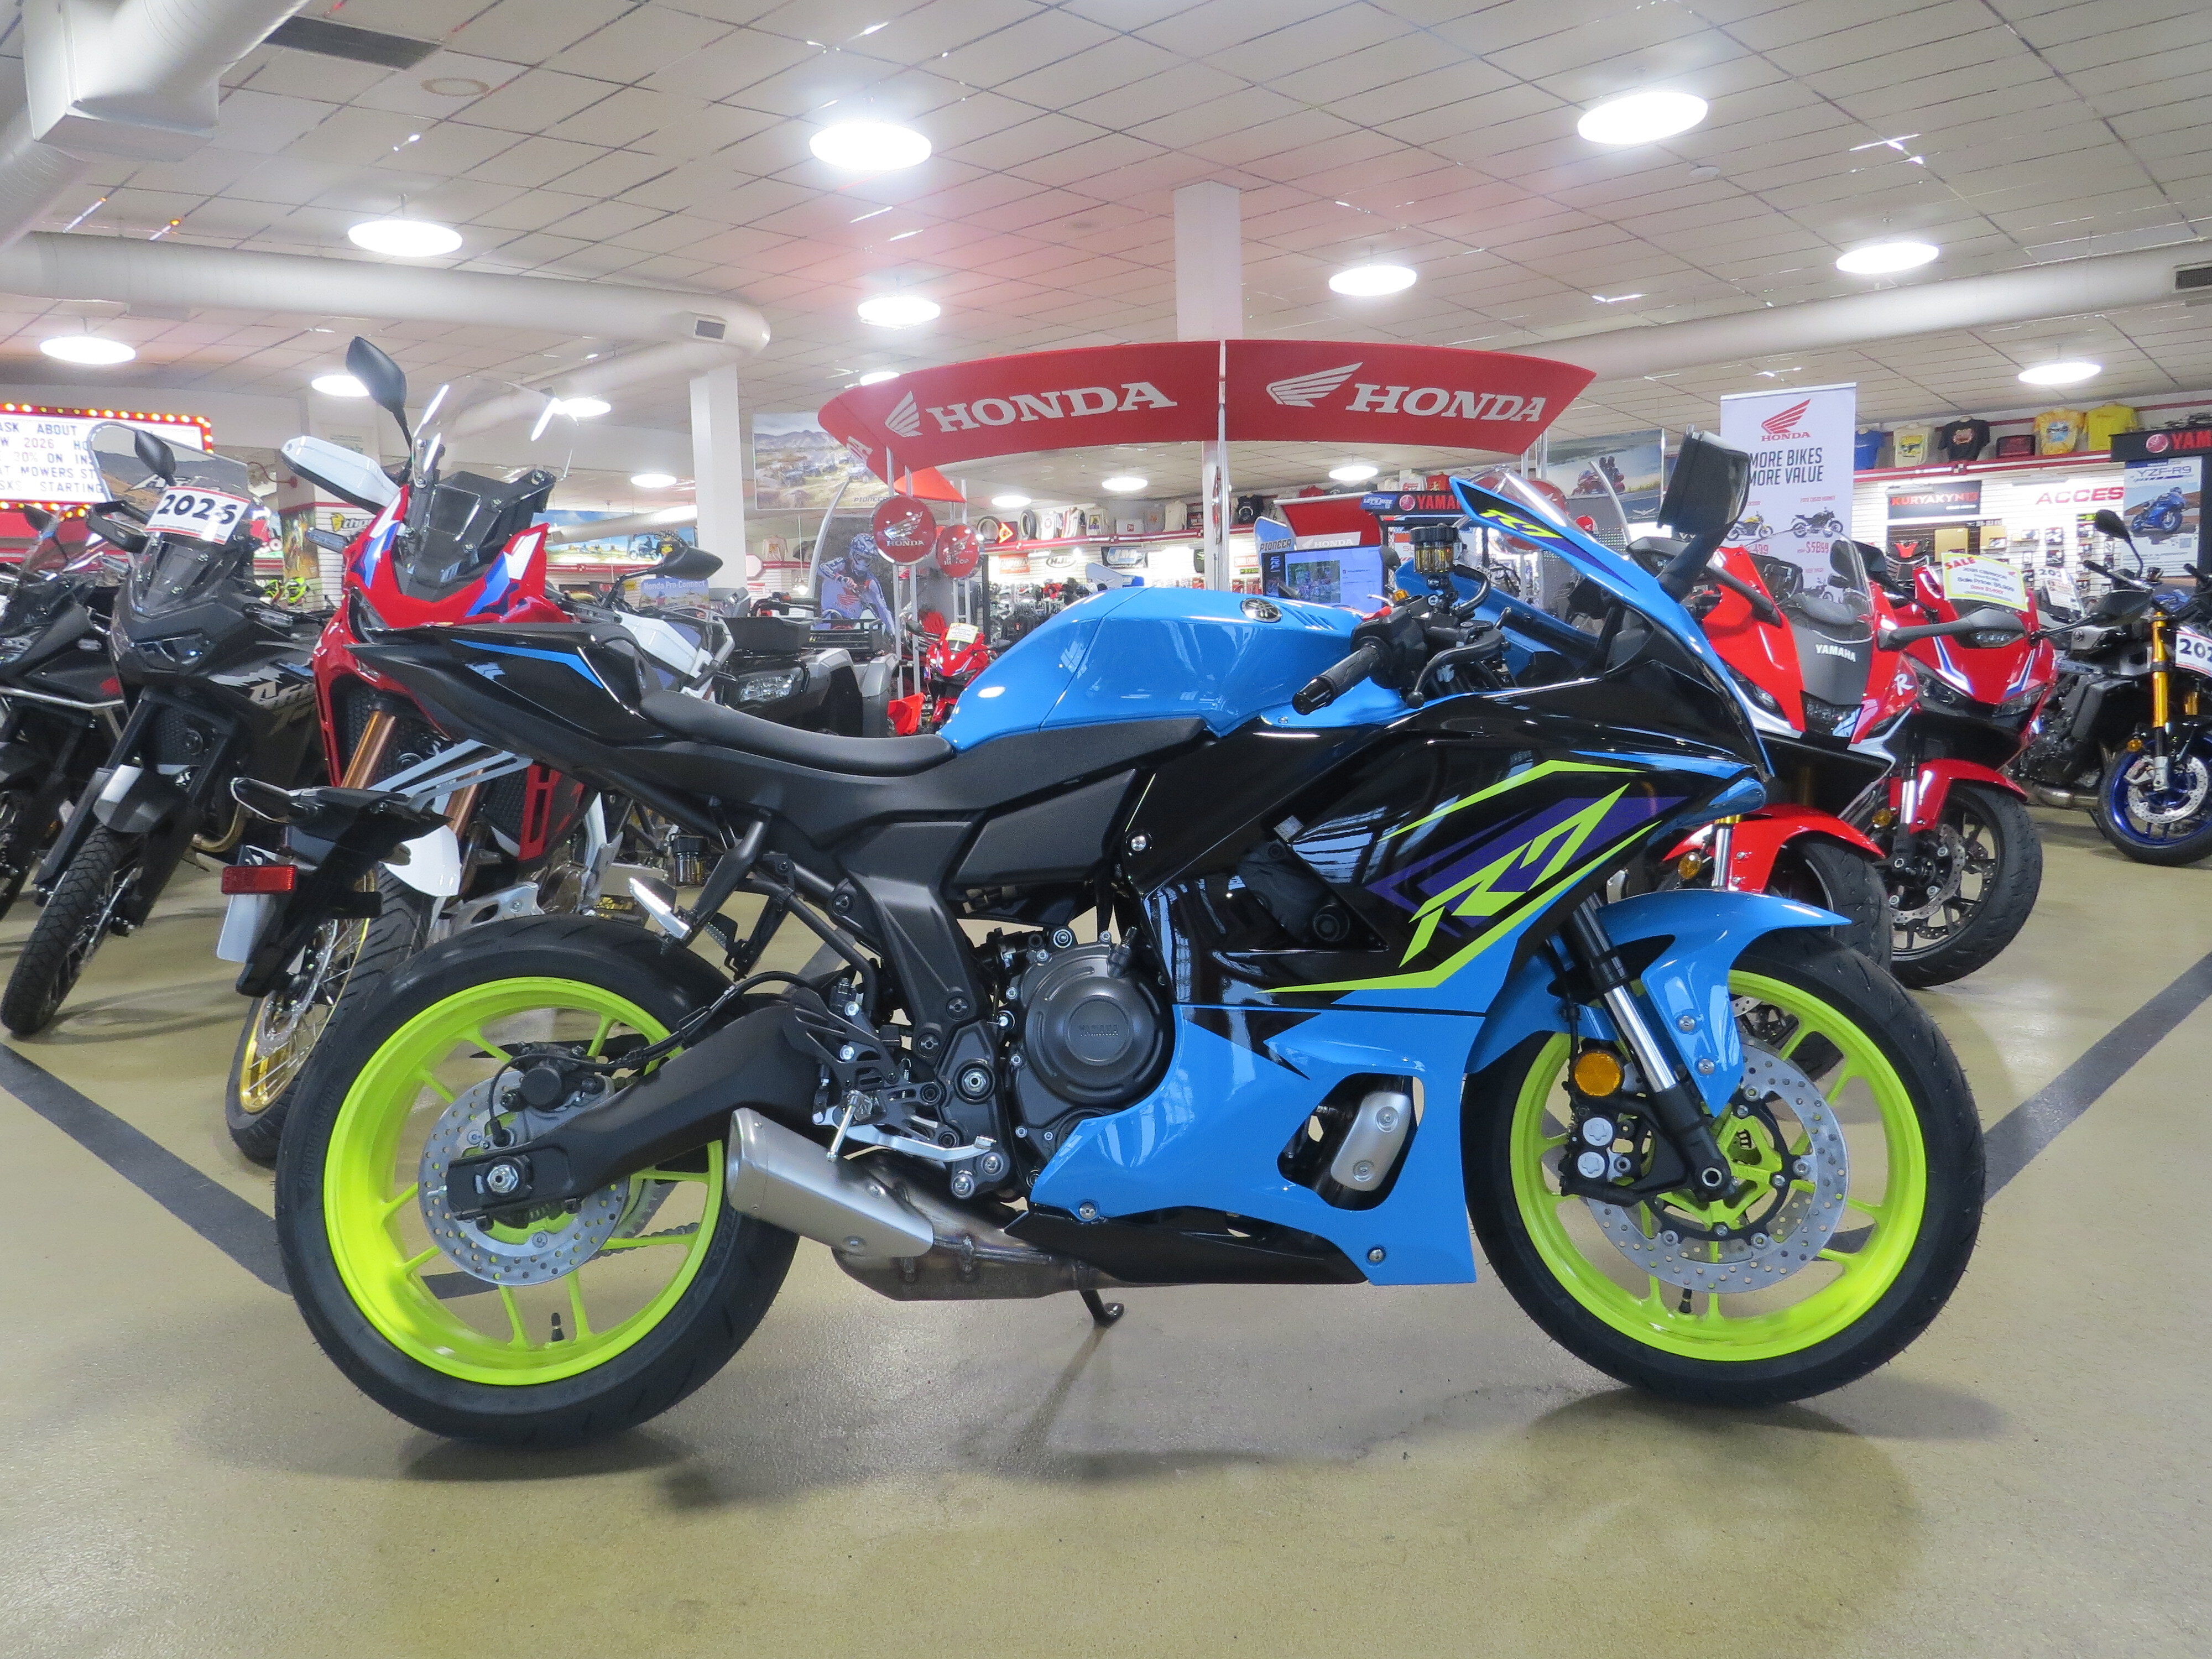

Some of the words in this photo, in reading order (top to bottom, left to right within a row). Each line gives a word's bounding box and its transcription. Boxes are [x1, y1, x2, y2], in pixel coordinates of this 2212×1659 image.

[925, 382, 1177, 432] HONDA
[1345, 383, 1546, 422] HONDA
[37, 424, 77, 436] ABOUT
[1761, 432, 1811, 441] HONDA
[24, 437, 54, 449] 2026
[14, 451, 39, 462] 30%
[47, 453, 63, 464] ON
[1750, 451, 1783, 468] MORE
[1787, 447, 1822, 466] BIKES
[20, 466, 74, 479] MOWERS
[1785, 465, 1823, 483] VALUE
[2137, 466, 2192, 477] YZF-R9
[40, 481, 103, 494] STARTING
[1891, 493, 1964, 506] KURYAKYN
[157, 494, 238, 525] 2025
[1260, 539, 1292, 551] PIONEER
[1314, 539, 1354, 547] HONDA
[1051, 556, 1072, 564] HJC
[1944, 556, 1976, 570] SALE
[644, 581, 665, 590] Honda
[1815, 644, 1856, 662] YAMAHA
[1894, 673, 1915, 696] R
